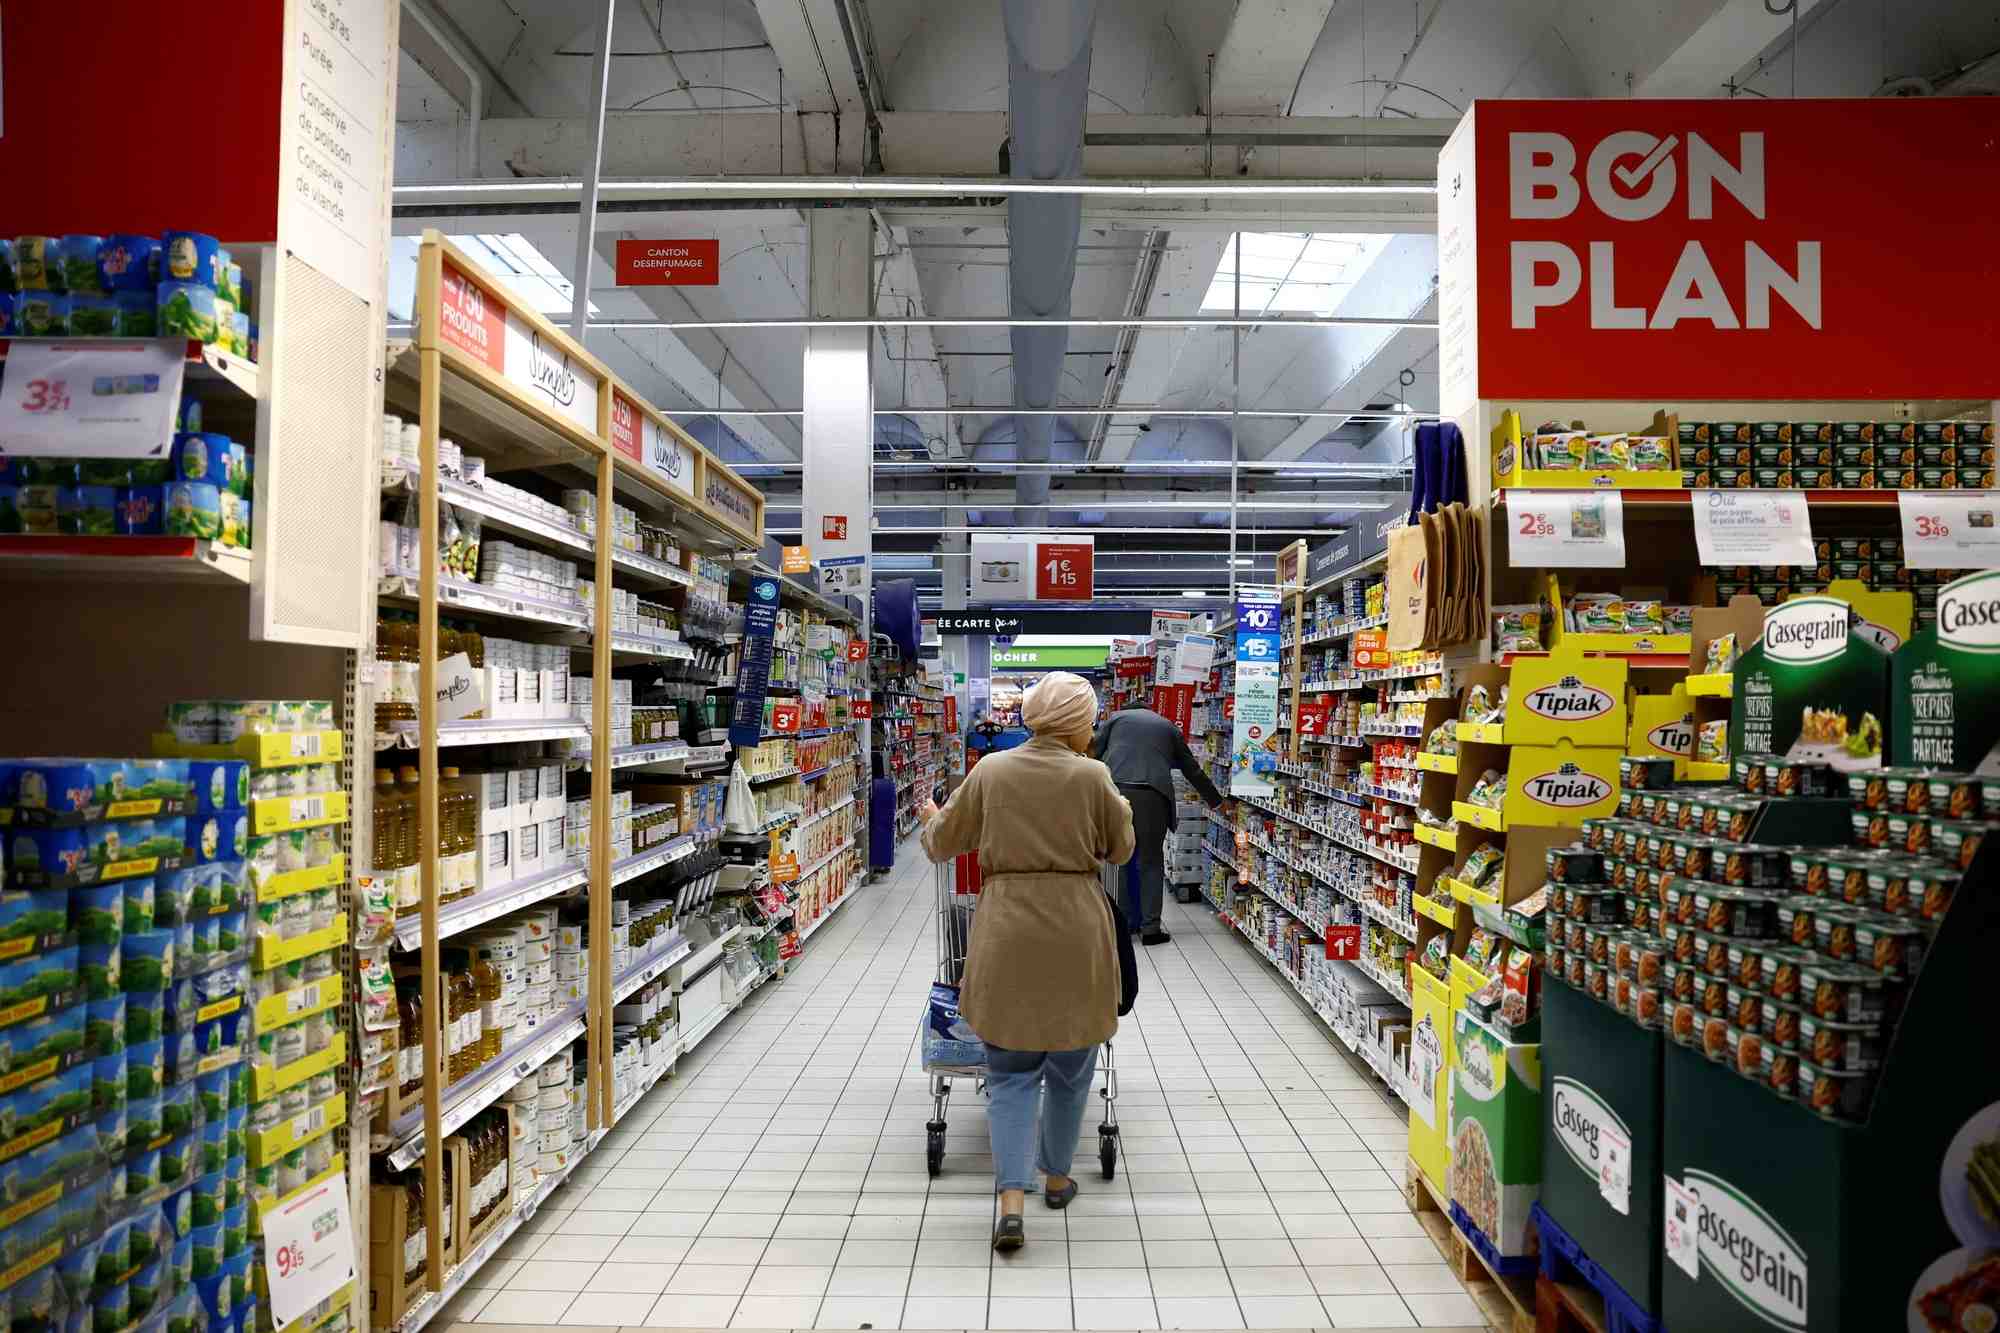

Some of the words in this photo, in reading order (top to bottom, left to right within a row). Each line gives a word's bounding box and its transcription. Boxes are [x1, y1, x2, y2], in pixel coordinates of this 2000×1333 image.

[328, 12, 350, 42] gras
[302, 32, 333, 74] Purée
[300, 82, 346, 135] Conserve
[299, 114, 312, 134] de
[314, 127, 352, 167] poisson
[297, 145, 344, 195] Conserve
[1509, 131, 1766, 222] BON
[296, 177, 309, 197] de
[311, 189, 345, 222] viande
[633, 259, 703, 268] DESENFUMAGE
[647, 248, 689, 257] CANTON
[1510, 240, 1822, 330] PLAN
[442, 302, 488, 347] PRODUITS
[954, 619, 991, 628] CARTE
[1766, 612, 1846, 648] Cassegrain
[1941, 597, 2000, 634] Casse
[1535, 692, 1601, 715] Tipiak
[1914, 695, 1951, 719] REPAS
[1301, 714, 1321, 732] 2€
[1744, 733, 1772, 752] PARTAGE
[1912, 738, 1954, 765] PARTAGE
[1535, 779, 1601, 802] Tipiak
[1334, 937, 1353, 957] 1€
[1555, 1091, 1600, 1160] Casseg
[1689, 1187, 1803, 1310] assegrain
